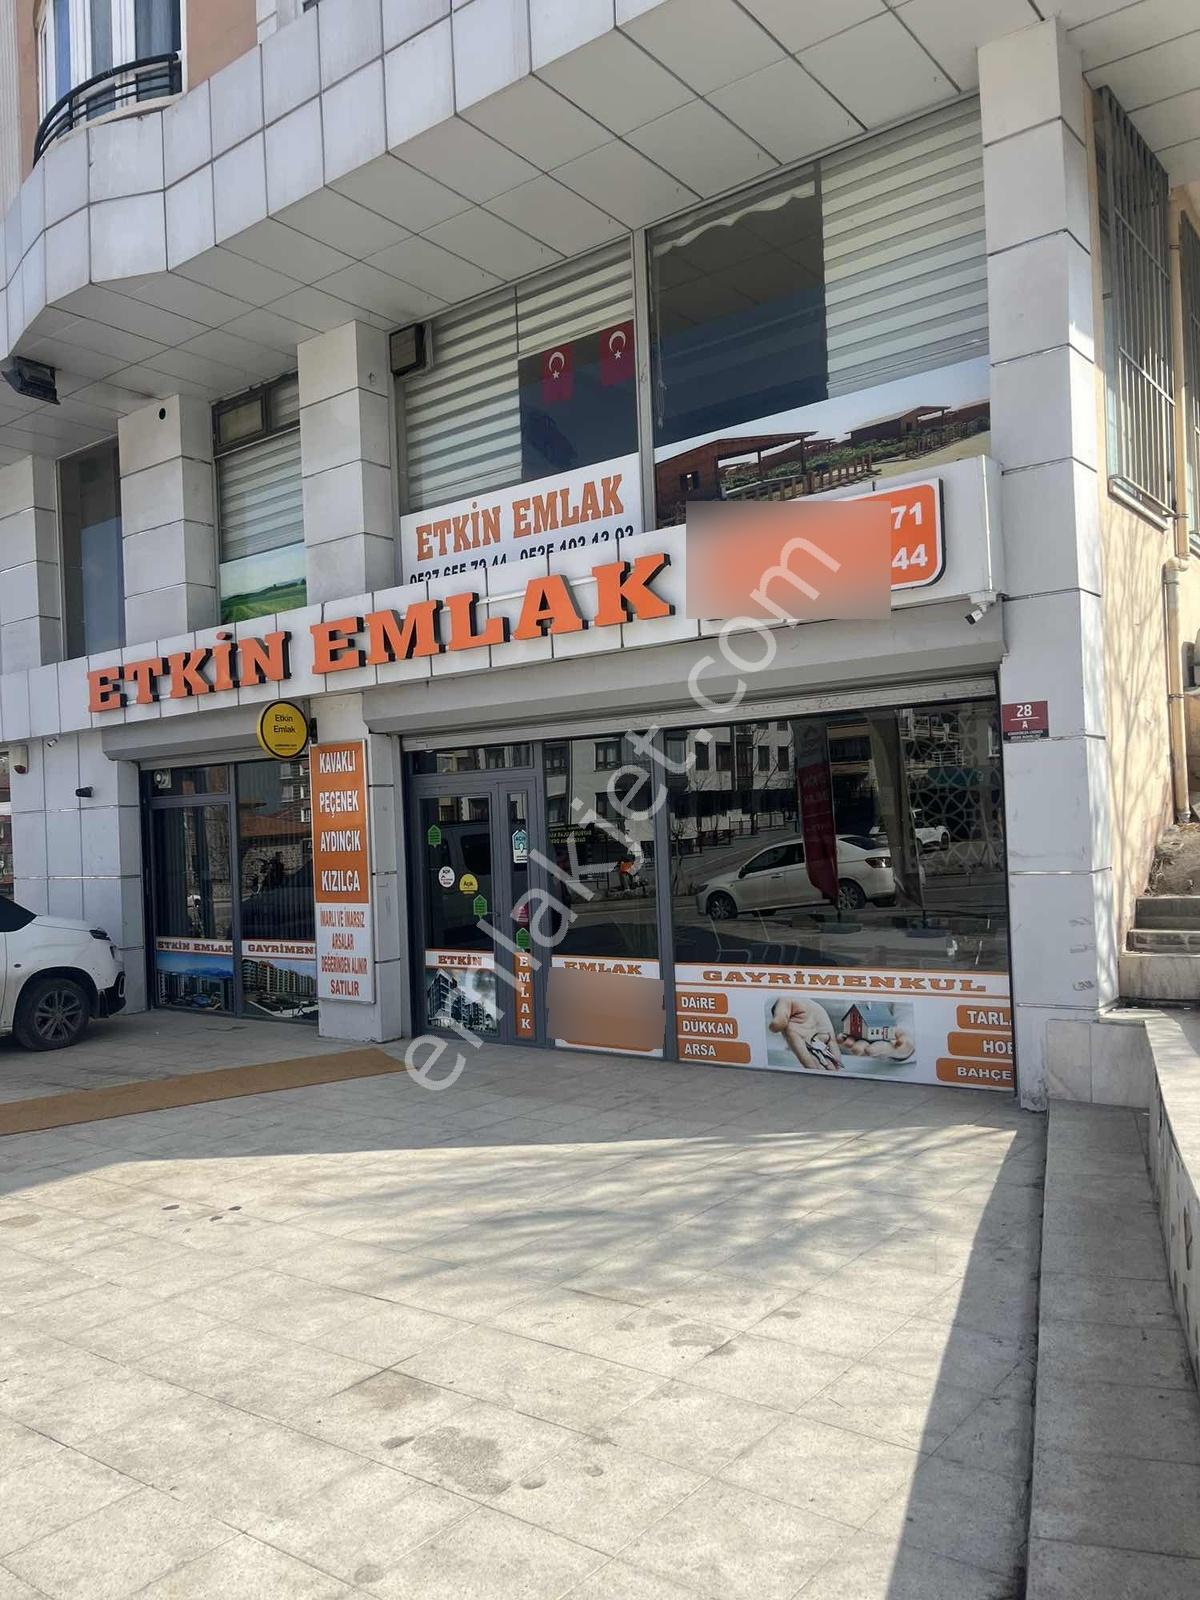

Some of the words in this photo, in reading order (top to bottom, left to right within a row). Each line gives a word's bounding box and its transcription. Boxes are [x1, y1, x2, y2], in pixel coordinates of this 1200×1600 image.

[416, 502, 501, 562] ETKİN
[512, 474, 624, 539] EMLAK
[891, 502, 922, 529] 71
[891, 543, 928, 570] 44
[88, 631, 292, 713] ETKİN
[310, 553, 676, 675] EMLAK
[275, 714, 294, 722] Etkin
[1016, 704, 1032, 718] 28
[274, 725, 296, 733] Emlak
[1022, 720, 1028, 729] A
[319, 751, 356, 774] KAVAKLI
[319, 790, 359, 818] PEÇENEK
[320, 830, 361, 852] AYDINCIK
[321, 870, 361, 892] KIZILCA
[157, 940, 190, 950] ETKİN
[193, 943, 232, 953] EMLAK
[437, 953, 482, 966] ETKİN
[331, 979, 360, 997] SATILIR
[702, 970, 987, 993] GAYRİMENKUL
[517, 955, 532, 1030] EMLAK
[682, 1018, 734, 1035] DÜKKAN
[966, 1010, 1013, 1026] TARL
[684, 1043, 717, 1057] ARSA
[957, 1066, 1012, 1081] BAHÇE
